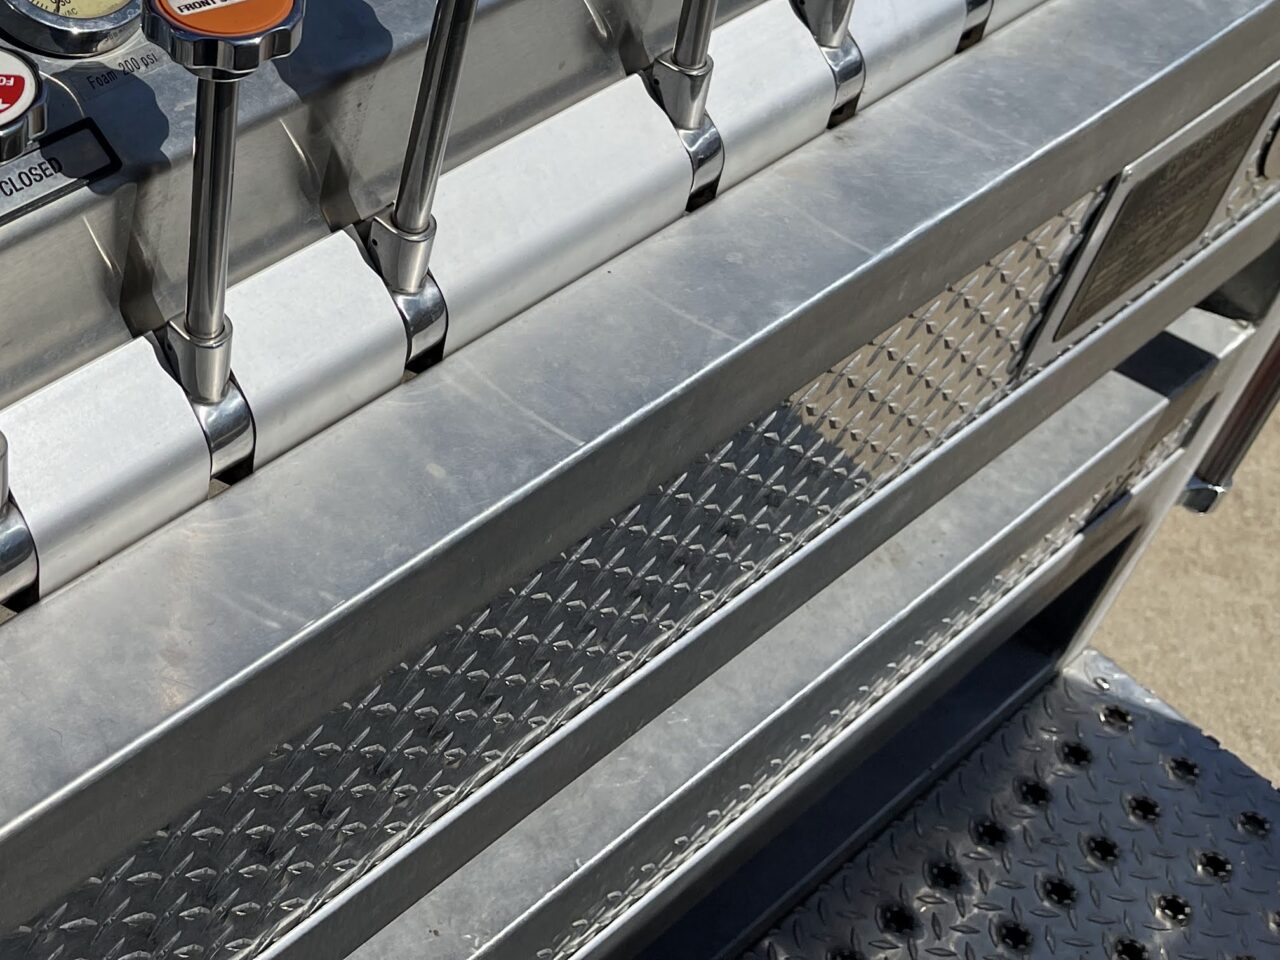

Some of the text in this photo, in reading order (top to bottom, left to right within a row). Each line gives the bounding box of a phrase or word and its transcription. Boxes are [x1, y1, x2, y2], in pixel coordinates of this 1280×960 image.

[87, 52, 158, 90] Foam 200 psi
